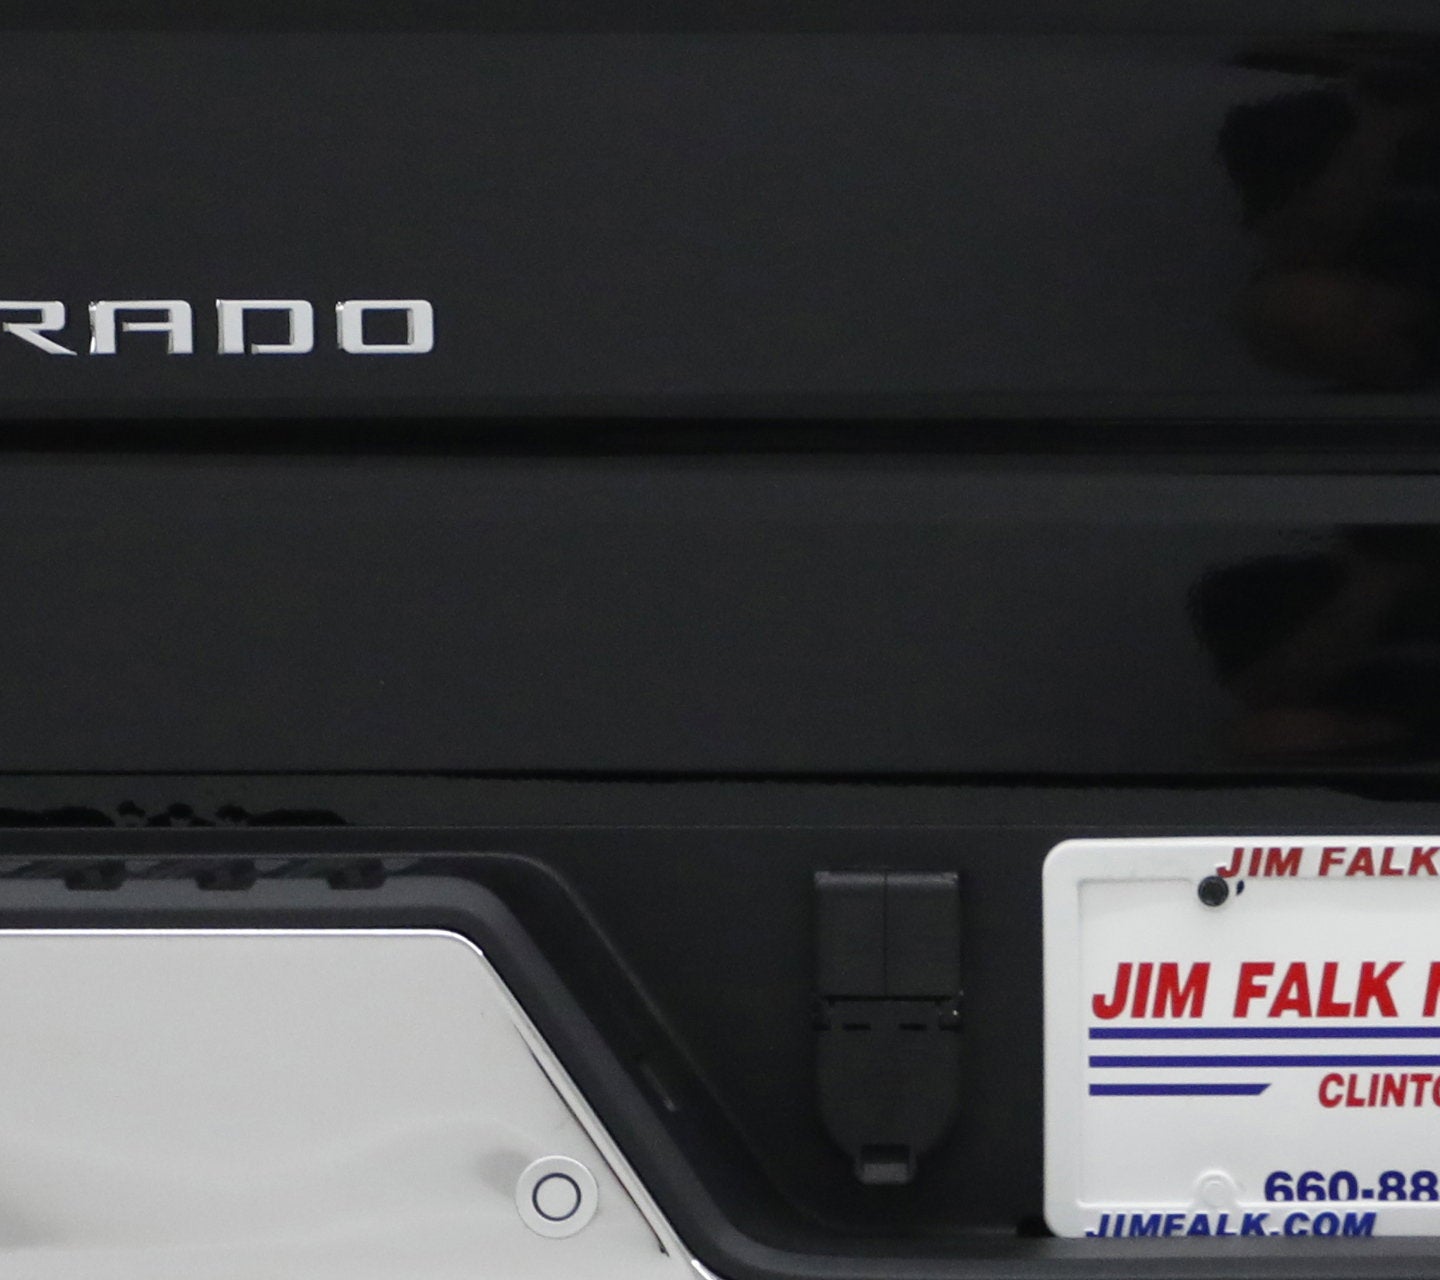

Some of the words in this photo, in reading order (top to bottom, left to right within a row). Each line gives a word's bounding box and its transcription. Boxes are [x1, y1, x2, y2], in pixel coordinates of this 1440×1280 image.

[1214, 846, 1303, 878] JIM
[1091, 962, 1210, 1020] JIM
[1232, 961, 1404, 1019] FALK
